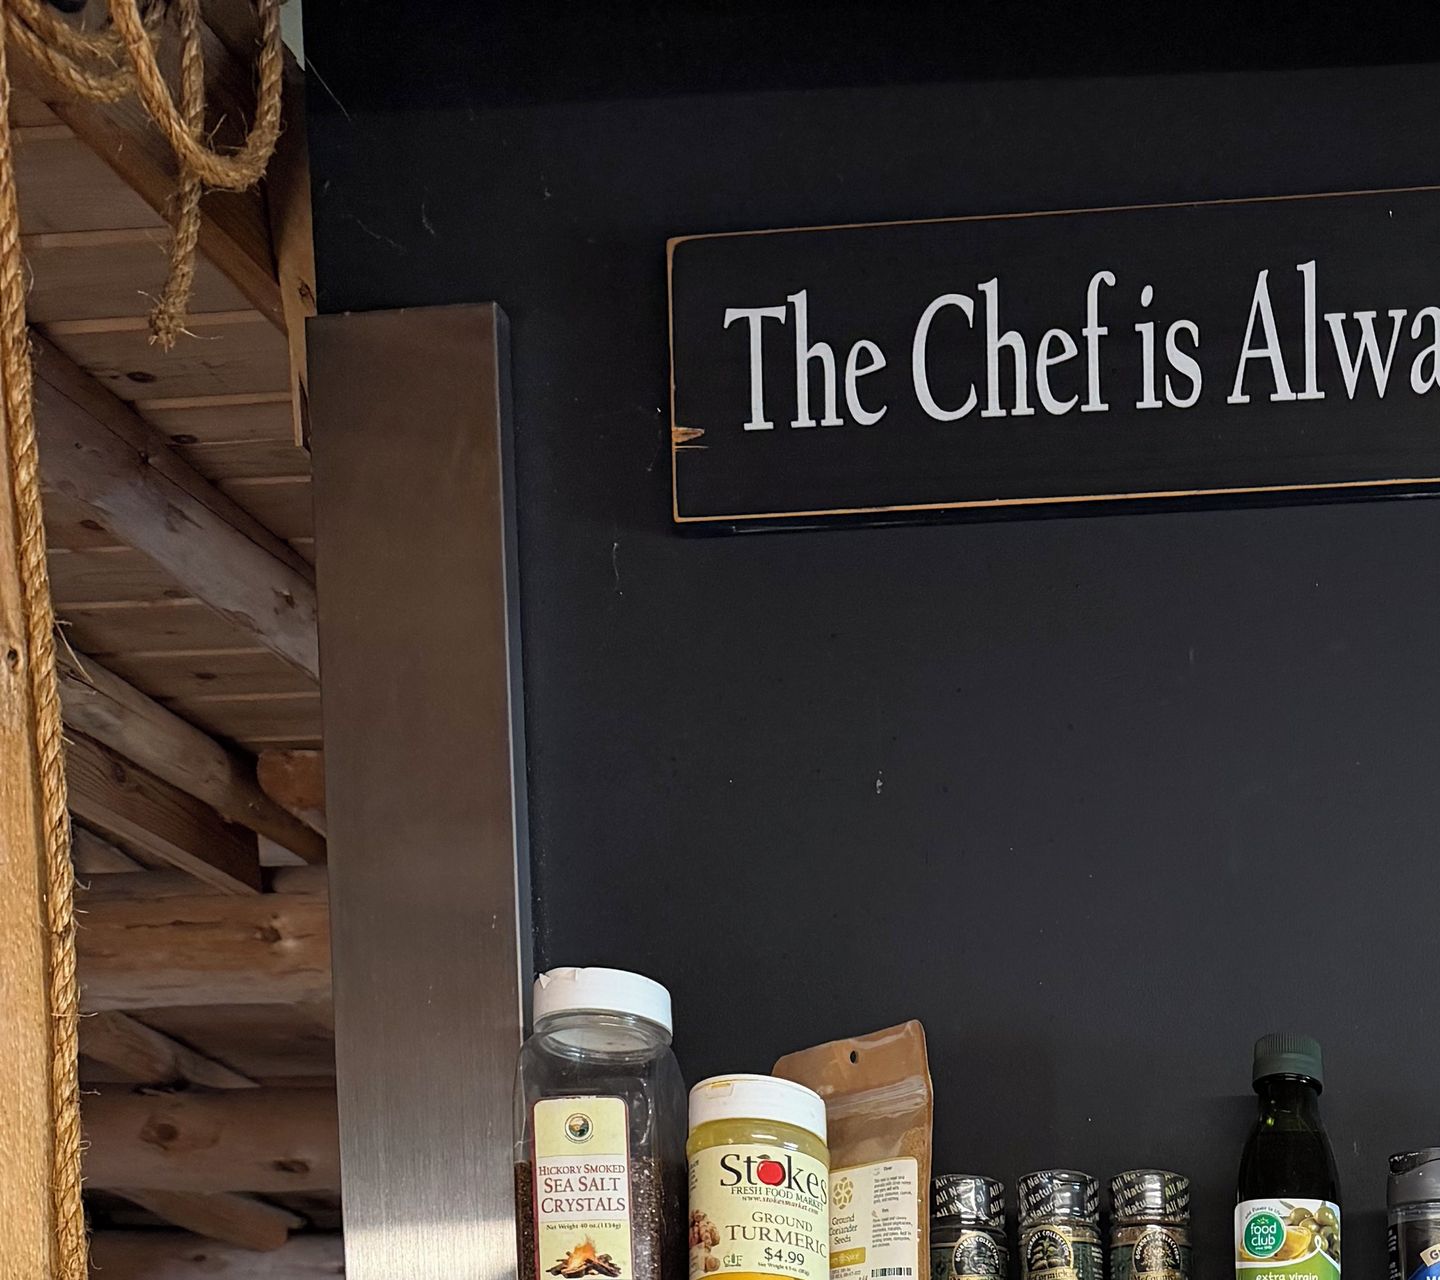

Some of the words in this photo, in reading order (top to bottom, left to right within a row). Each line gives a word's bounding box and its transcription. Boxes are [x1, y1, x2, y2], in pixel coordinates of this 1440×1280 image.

[724, 290, 886, 430] The
[912, 271, 1118, 418] Chef
[1136, 284, 1202, 408] is
[539, 1166, 582, 1176] HICKORY
[584, 1164, 625, 1174] SMOKED
[544, 1178, 574, 1194] SEA
[579, 1176, 621, 1192] SALT
[542, 1198, 626, 1214] CRYSTALS
[731, 1187, 762, 1195] FRESH
[766, 1188, 793, 1199] FOOD
[796, 1194, 824, 1212] MARKET
[936, 1190, 948, 1206] All
[752, 1211, 813, 1232] GROUND
[832, 1213, 855, 1226] Ground
[1250, 1222, 1277, 1235] food
[725, 1225, 827, 1258] TURMERIC
[834, 1236, 851, 1245] Seeds
[1251, 1235, 1276, 1246] club
[764, 1247, 805, 1266] $4.99
